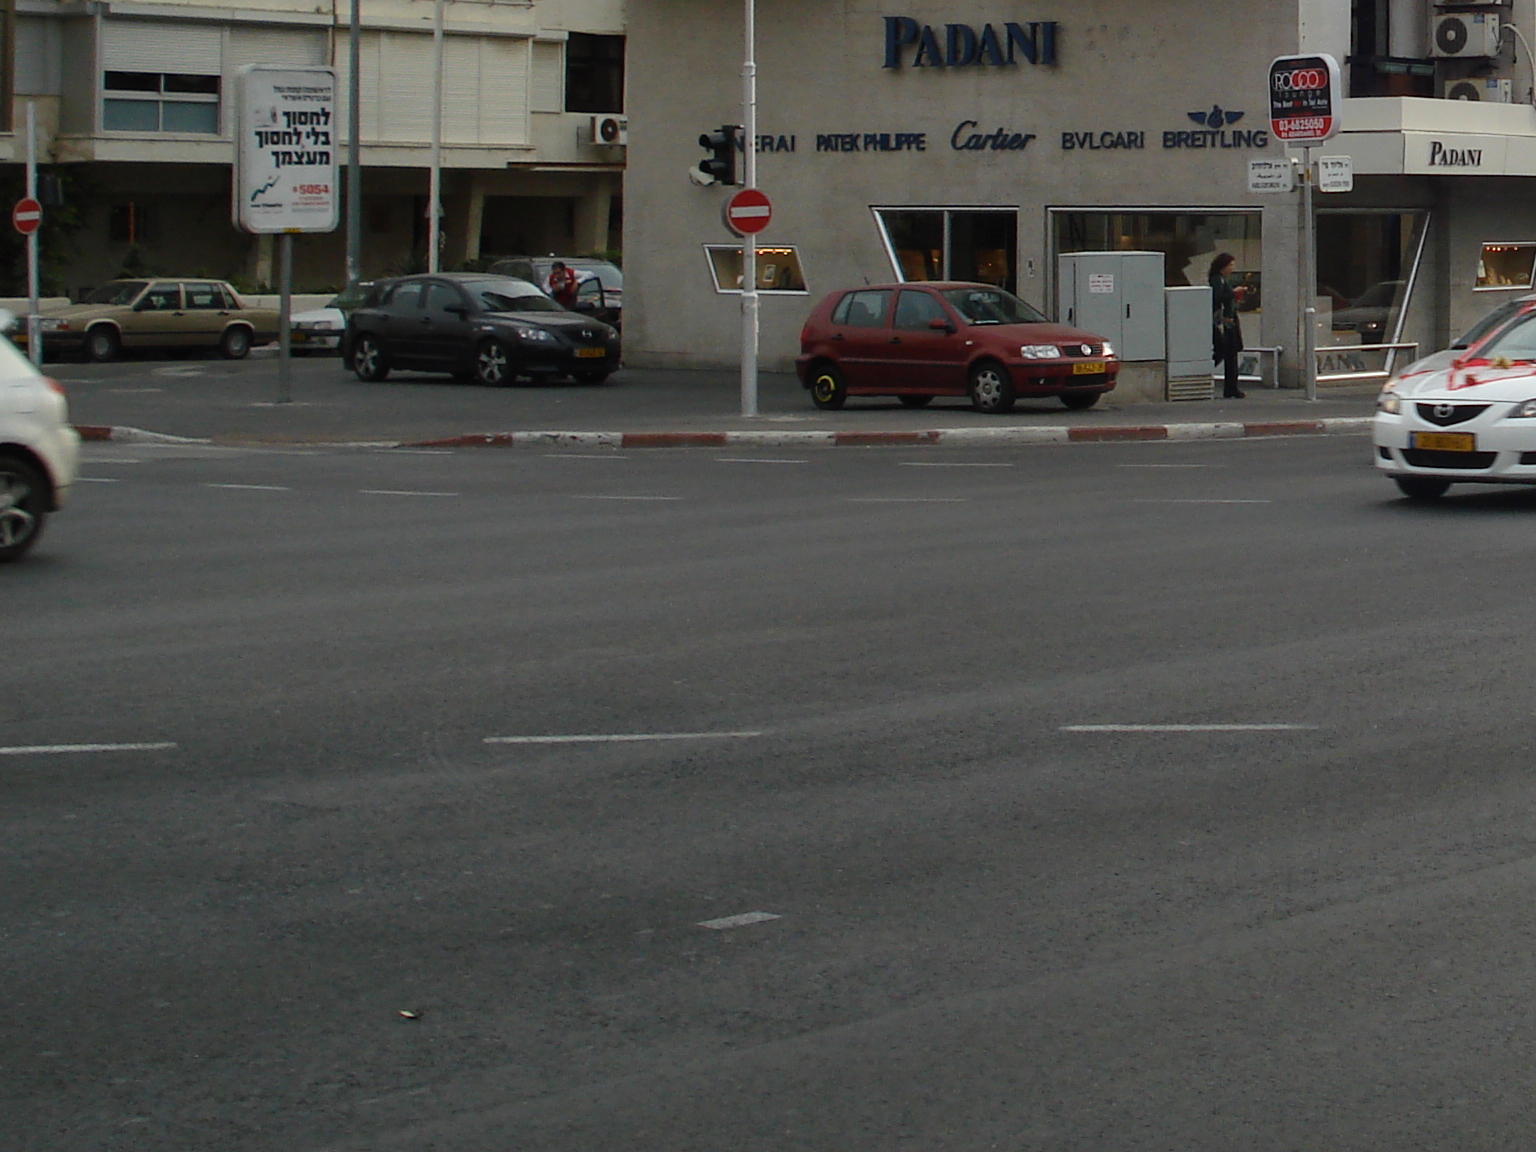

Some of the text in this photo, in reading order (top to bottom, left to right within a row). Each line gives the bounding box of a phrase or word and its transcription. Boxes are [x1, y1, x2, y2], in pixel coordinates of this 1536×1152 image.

[882, 16, 1058, 68] PADANI
[282, 107, 331, 128] לחסוך
[254, 127, 331, 148] בלי לחסוך
[816, 133, 926, 152] PATEK PHILIPPE
[951, 120, 1036, 151] Cartier
[1061, 131, 1144, 150] BVLGARI
[1162, 130, 1268, 149] BREITLING
[271, 150, 331, 169] מעצמך
[1428, 141, 1482, 167] PADANI
